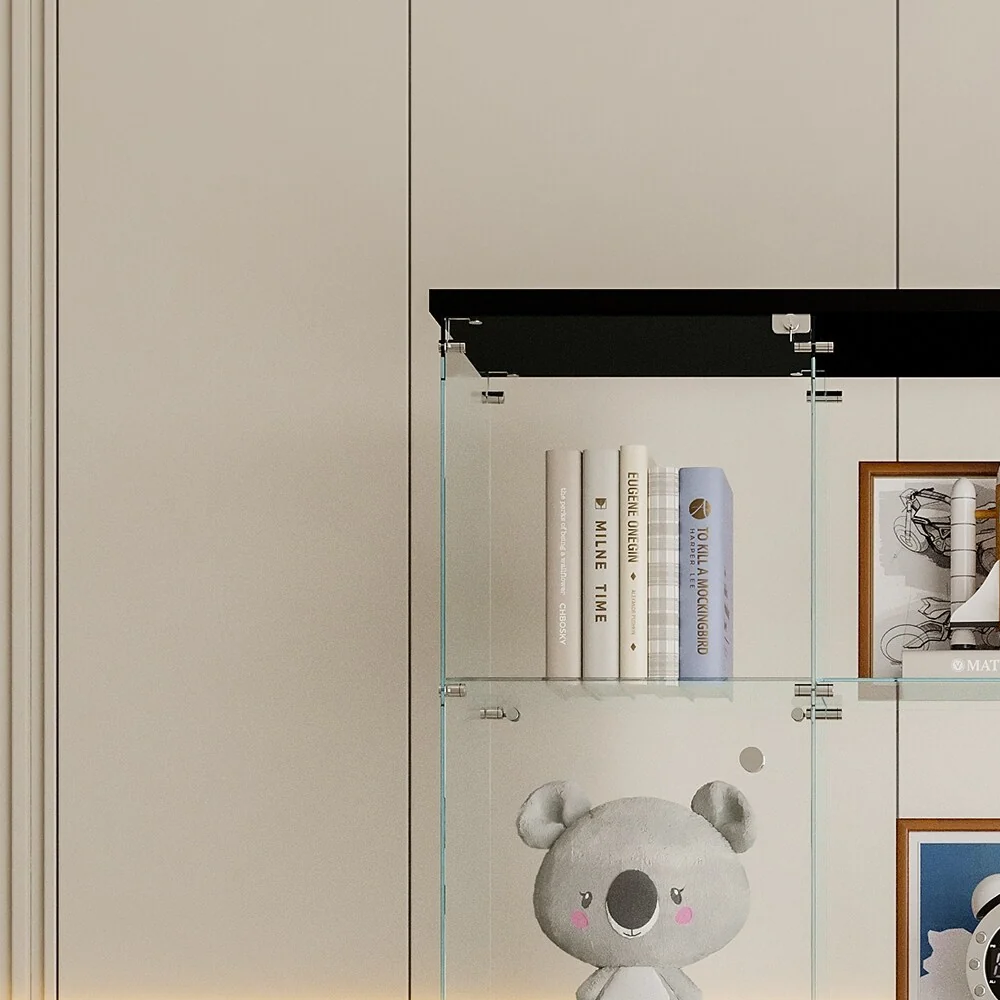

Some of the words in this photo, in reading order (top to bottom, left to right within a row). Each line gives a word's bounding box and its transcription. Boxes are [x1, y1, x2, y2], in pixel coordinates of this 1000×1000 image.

[627, 472, 639, 517] EUGENE
[595, 520, 607, 570] MILNE
[627, 521, 639, 563] ONEGIN
[697, 527, 709, 540] TO
[697, 544, 709, 564] KILL
[697, 567, 709, 576] A
[559, 603, 567, 645] CHBOSKY
[595, 584, 607, 623] TIME
[697, 578, 709, 655] MOCKINGBIRD
